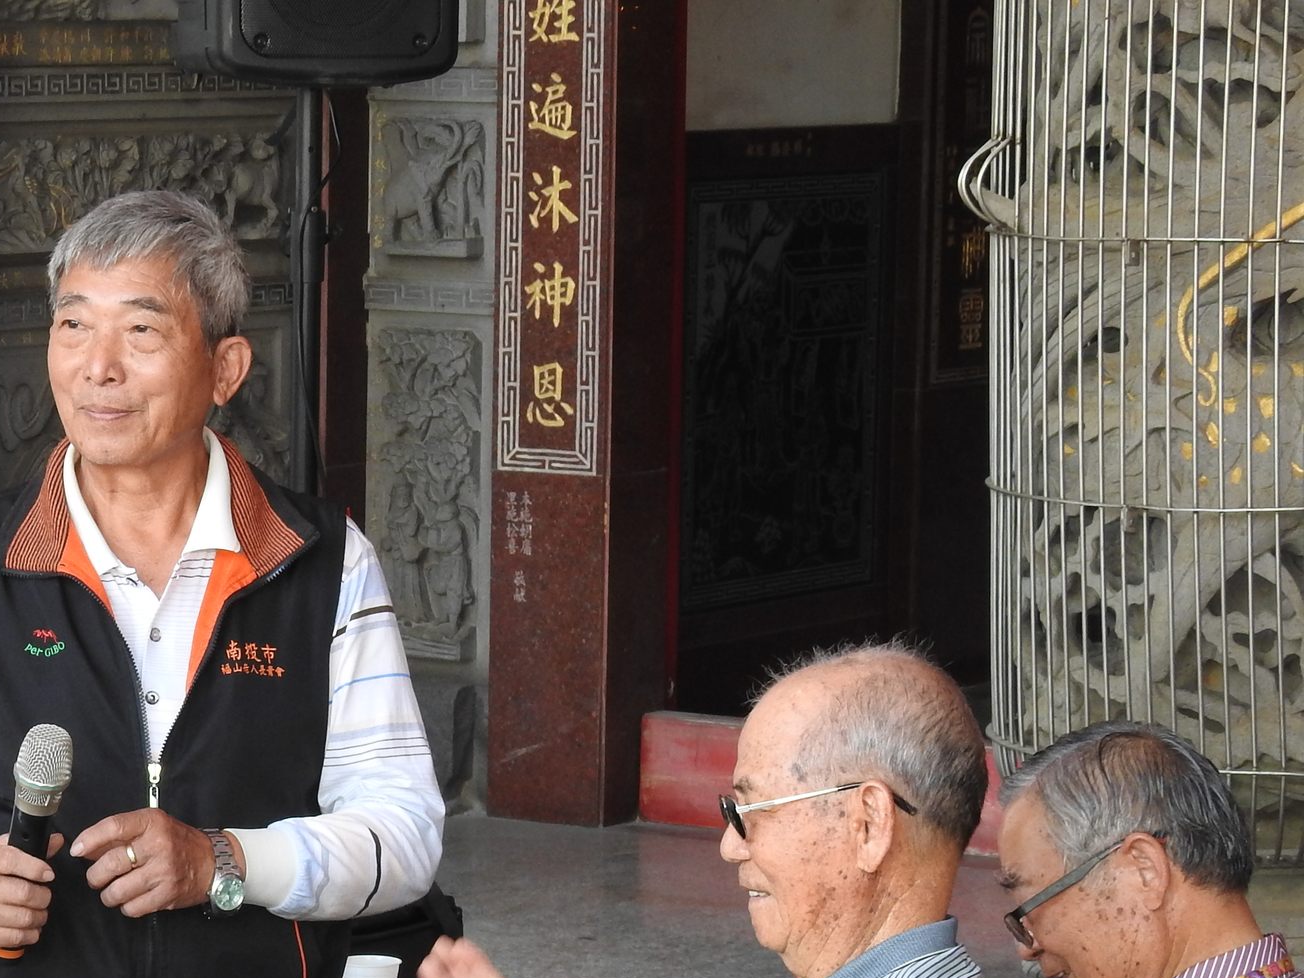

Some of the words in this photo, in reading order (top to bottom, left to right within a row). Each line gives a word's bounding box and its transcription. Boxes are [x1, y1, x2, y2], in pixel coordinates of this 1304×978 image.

[524, 0, 580, 428] 姓遍沐神恩
[44, 641, 65, 657] GIBO
[226, 640, 277, 664] 南投市
